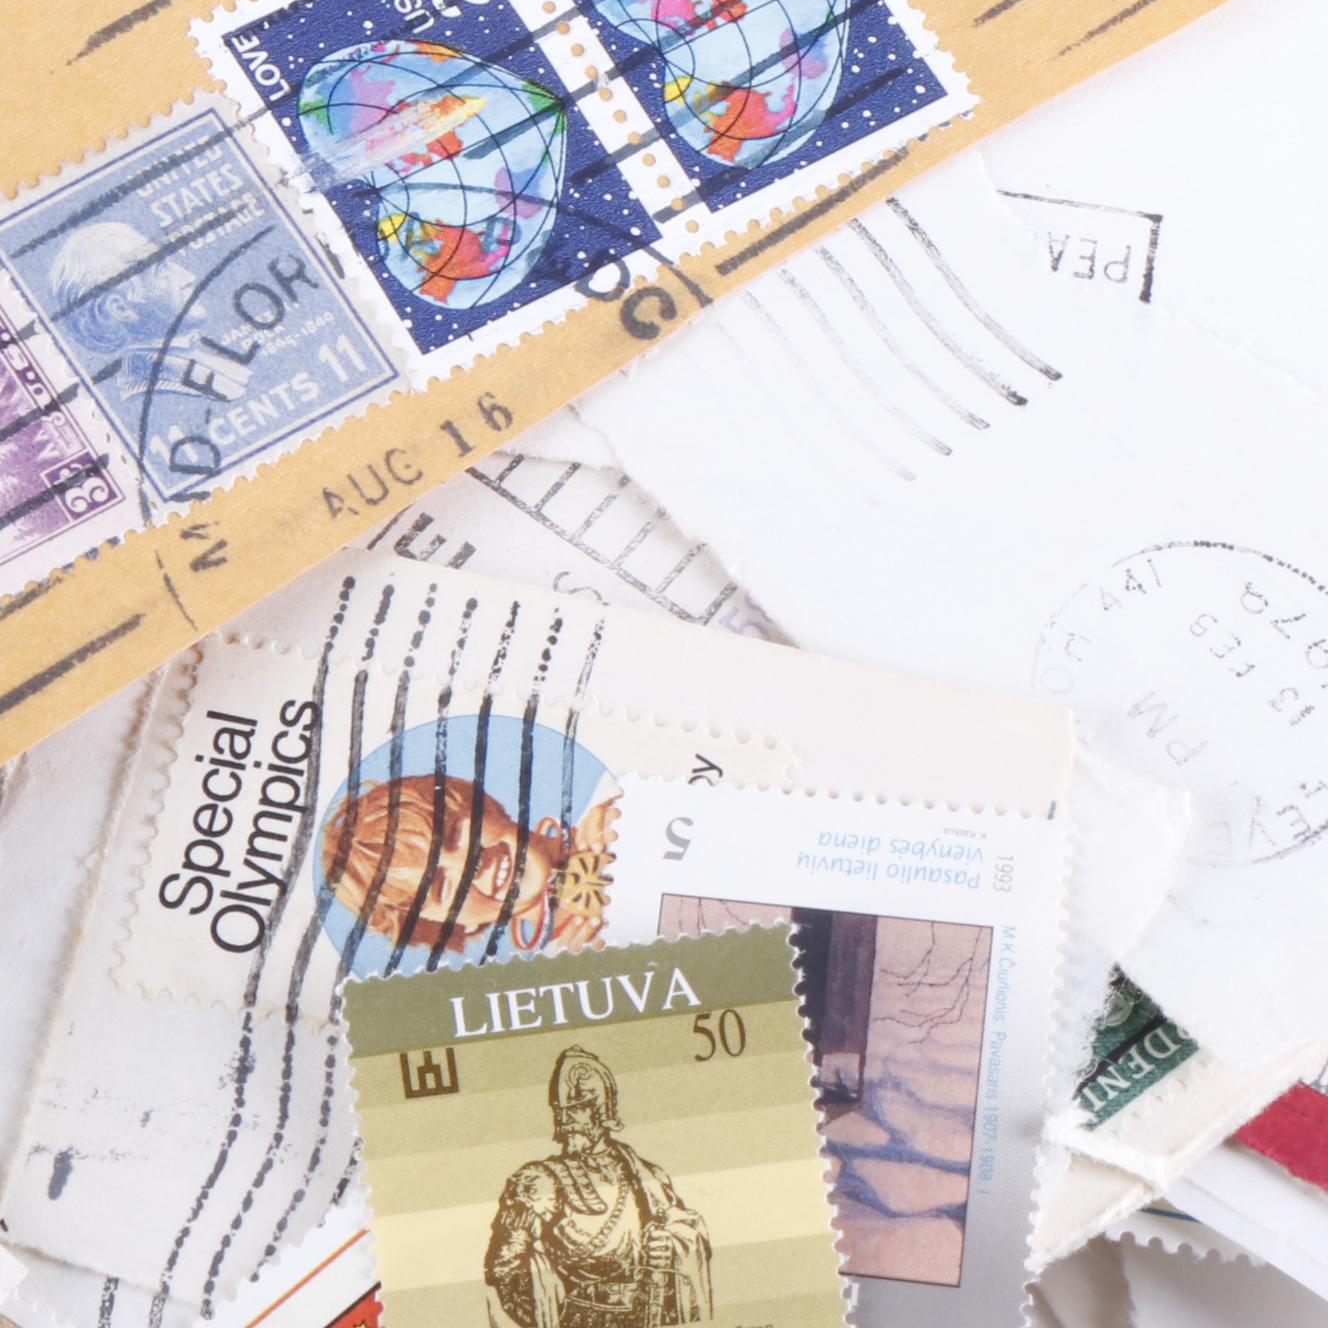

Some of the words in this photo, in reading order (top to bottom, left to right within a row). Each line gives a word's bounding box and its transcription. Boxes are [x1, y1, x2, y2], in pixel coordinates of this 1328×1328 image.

[229, 32, 291, 102] LOVE
[148, 160, 244, 230] STATES
[205, 366, 323, 450] CENTS
[313, 330, 369, 388] 11
[322, 448, 423, 520] AUG
[440, 391, 514, 459] 16
[158, 709, 260, 917] Special
[208, 697, 322, 954] Olympics
[663, 816, 697, 862] 5
[816, 830, 881, 856] diena
[794, 848, 880, 878] lietuvių
[884, 861, 983, 889] Pasaulio
[887, 834, 986, 864] vienybės
[991, 854, 1014, 892] 1993
[449, 966, 701, 1040] LIETUVA
[692, 1010, 748, 1062] 50
[1081, 1026, 1187, 1112] DENI
